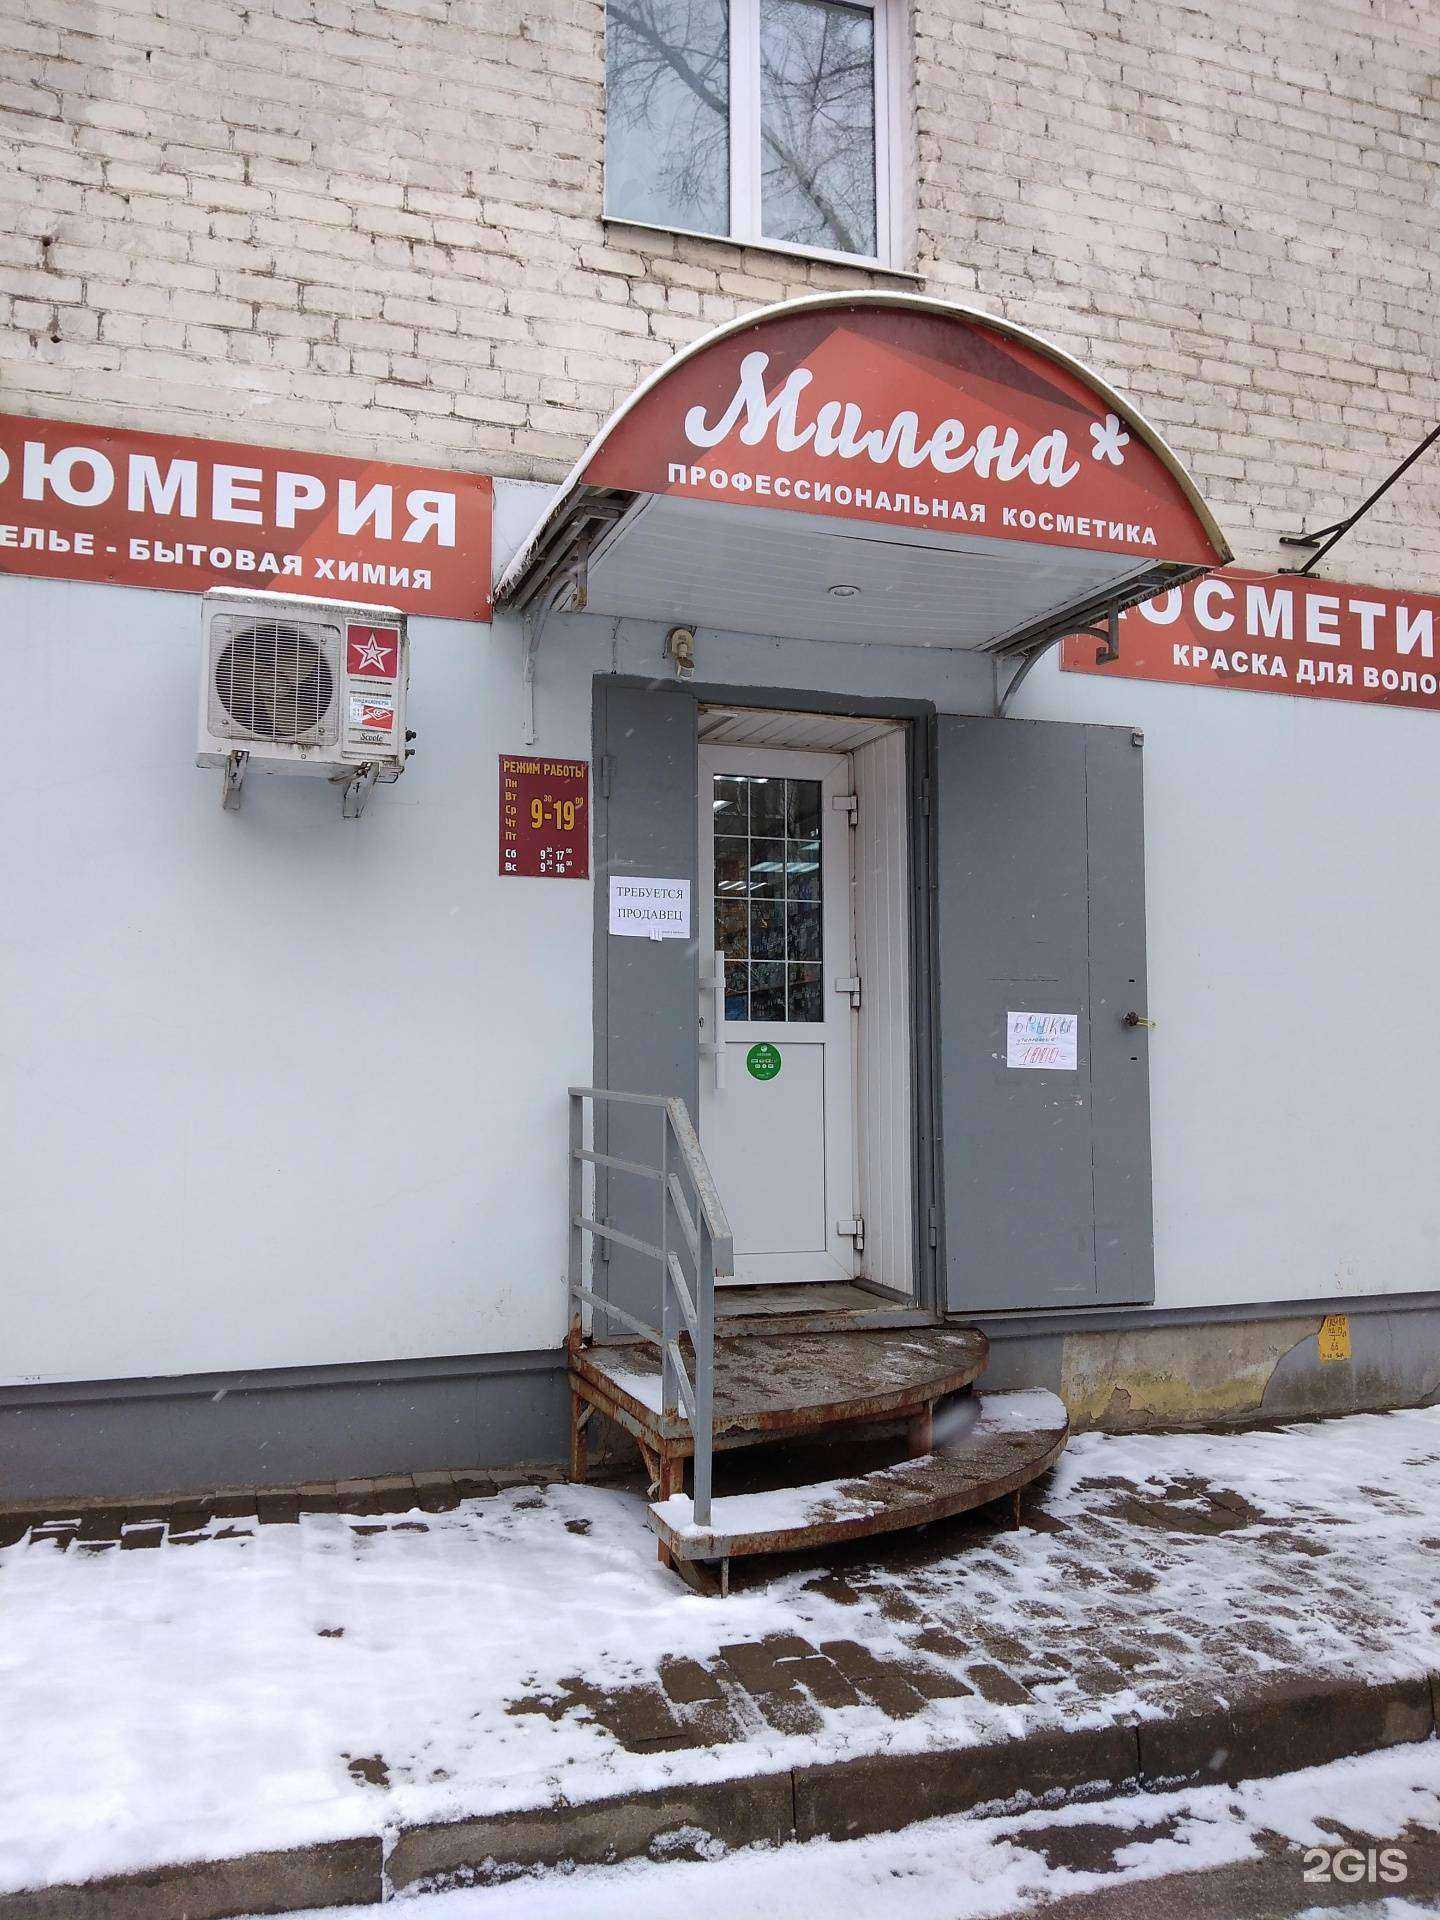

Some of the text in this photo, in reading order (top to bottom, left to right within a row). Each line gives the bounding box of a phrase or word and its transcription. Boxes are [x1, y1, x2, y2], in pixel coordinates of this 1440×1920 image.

[684, 350, 1081, 489] Милена
[667, 462, 1159, 547] ПРОФЕССИОНАЛЬНАЯ КОСМЕТИКА
[128, 539, 303, 577] БЫТОВАЯ
[314, 557, 432, 591] ХИМИЯ
[1118, 579, 1434, 658] ОСМЕТИ
[1173, 643, 1440, 695] КРАСКА ДЛЯ ВОЛО
[503, 760, 585, 779] РЕЖИМ РАБОТЫ
[505, 778, 518, 789] Пн
[505, 791, 517, 801] Вт
[505, 804, 517, 816] Ср
[505, 818, 517, 828] Чт
[505, 831, 517, 841] Пт
[505, 848, 517, 859] Сб
[505, 862, 517, 872] Вс
[616, 886, 683, 899] ТРЕБУЕТСЯ
[617, 908, 683, 922] ПРОДАВЕЦ
